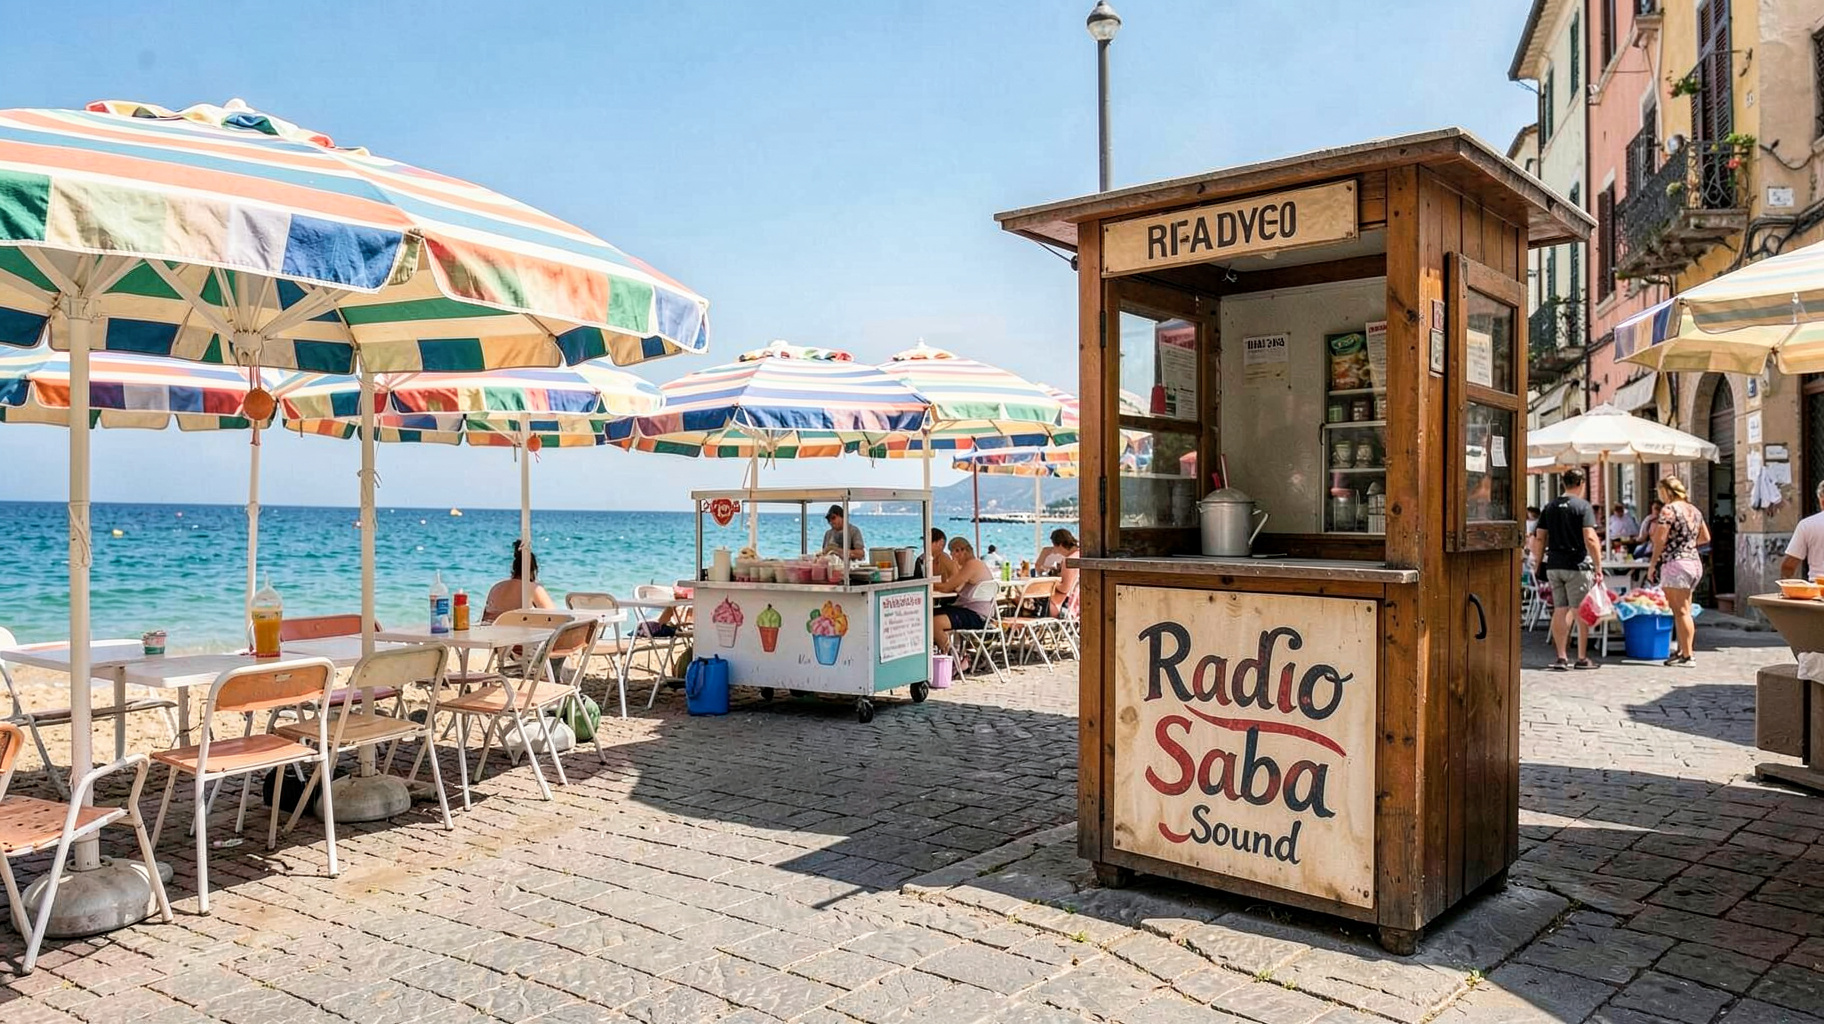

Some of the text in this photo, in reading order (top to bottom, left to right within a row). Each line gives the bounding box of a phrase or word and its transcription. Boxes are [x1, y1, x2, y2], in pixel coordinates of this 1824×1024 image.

[1138, 622, 1354, 719] Radio
[1145, 714, 1336, 818] Saba
[1190, 805, 1302, 865] Sound
